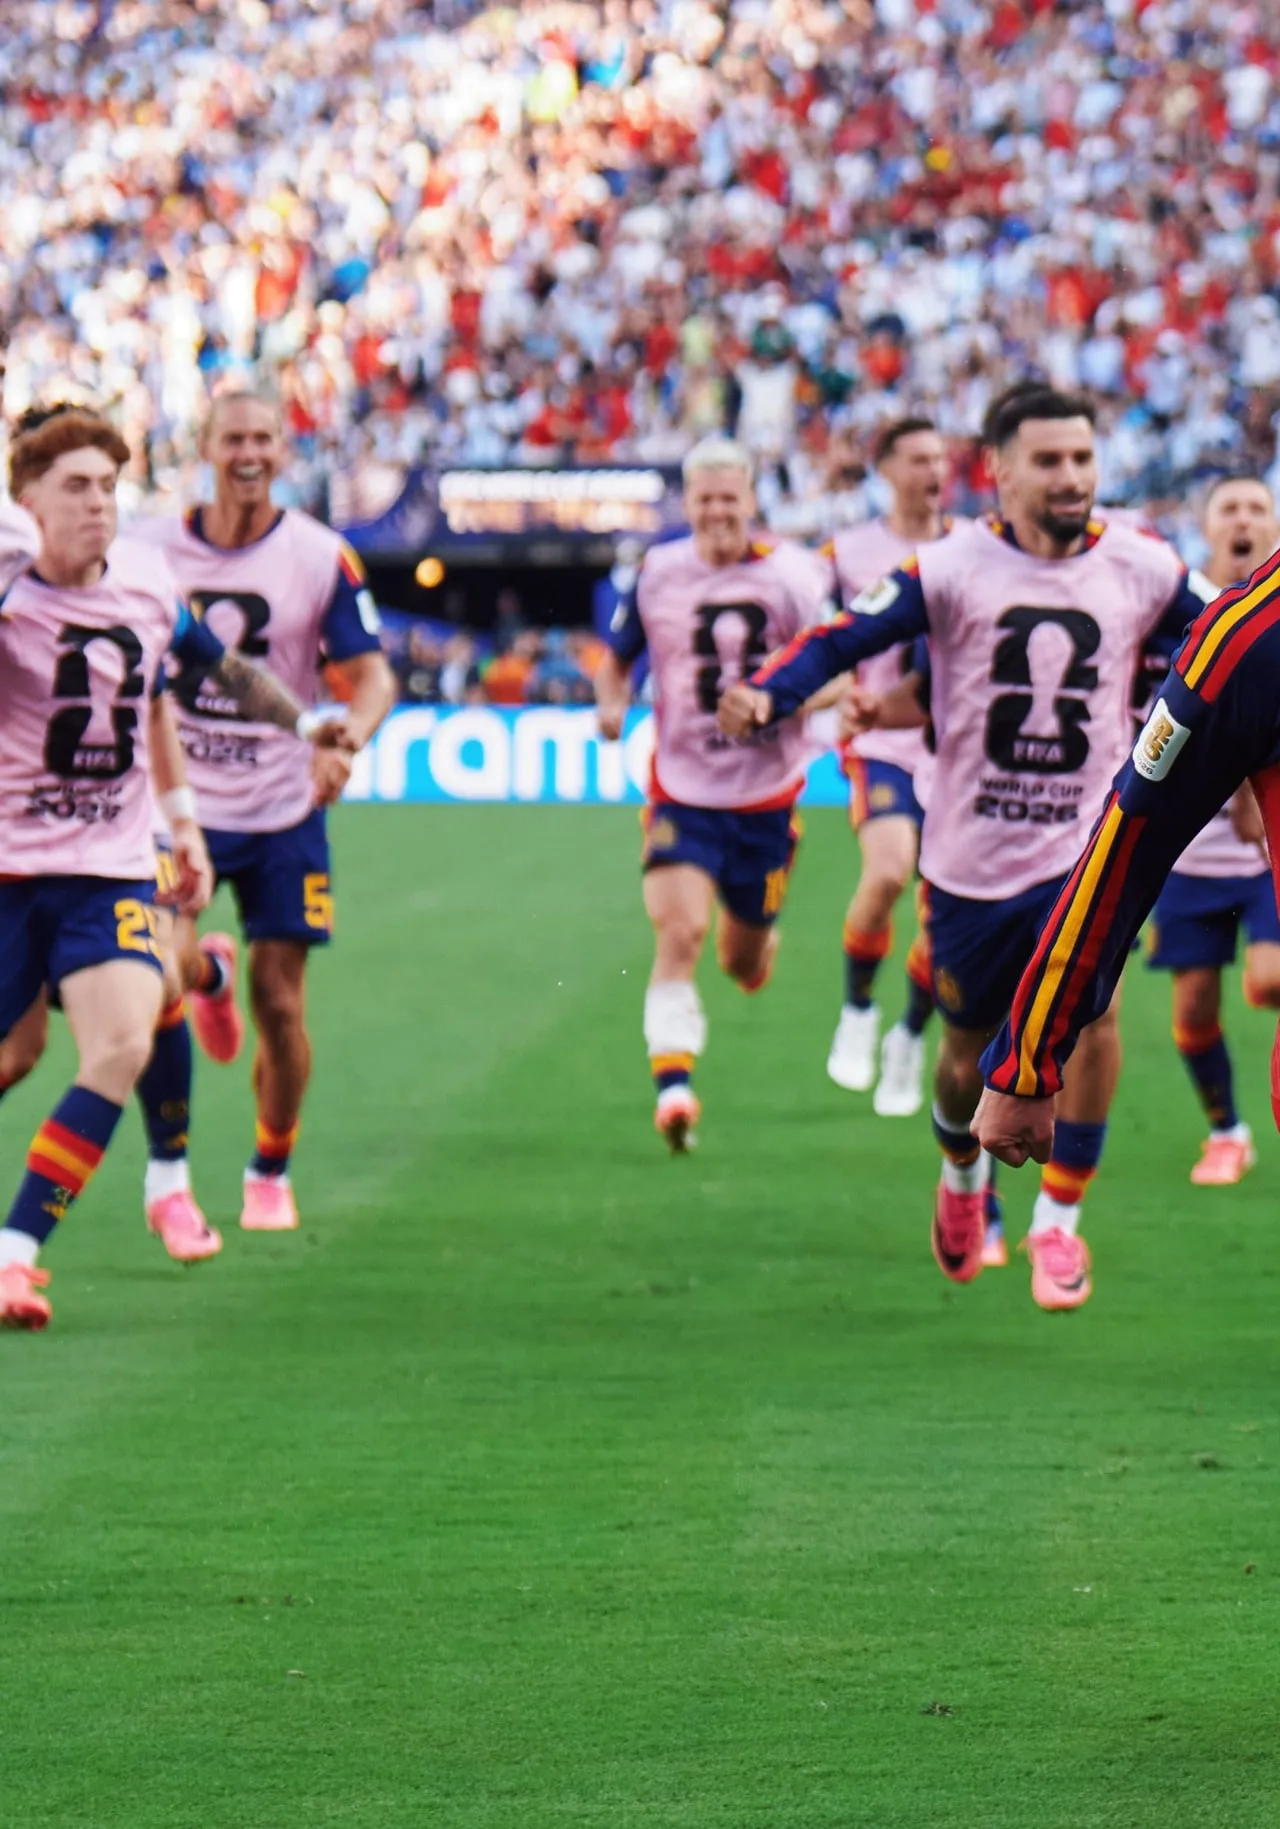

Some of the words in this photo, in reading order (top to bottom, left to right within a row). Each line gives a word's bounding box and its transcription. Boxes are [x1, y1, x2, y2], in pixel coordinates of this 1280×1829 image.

[72, 750, 118, 769] FIFA
[1013, 740, 1064, 762] FIFA
[1048, 783, 1084, 799] CUP
[973, 794, 1079, 824] 2026
[303, 872, 335, 933] 5
